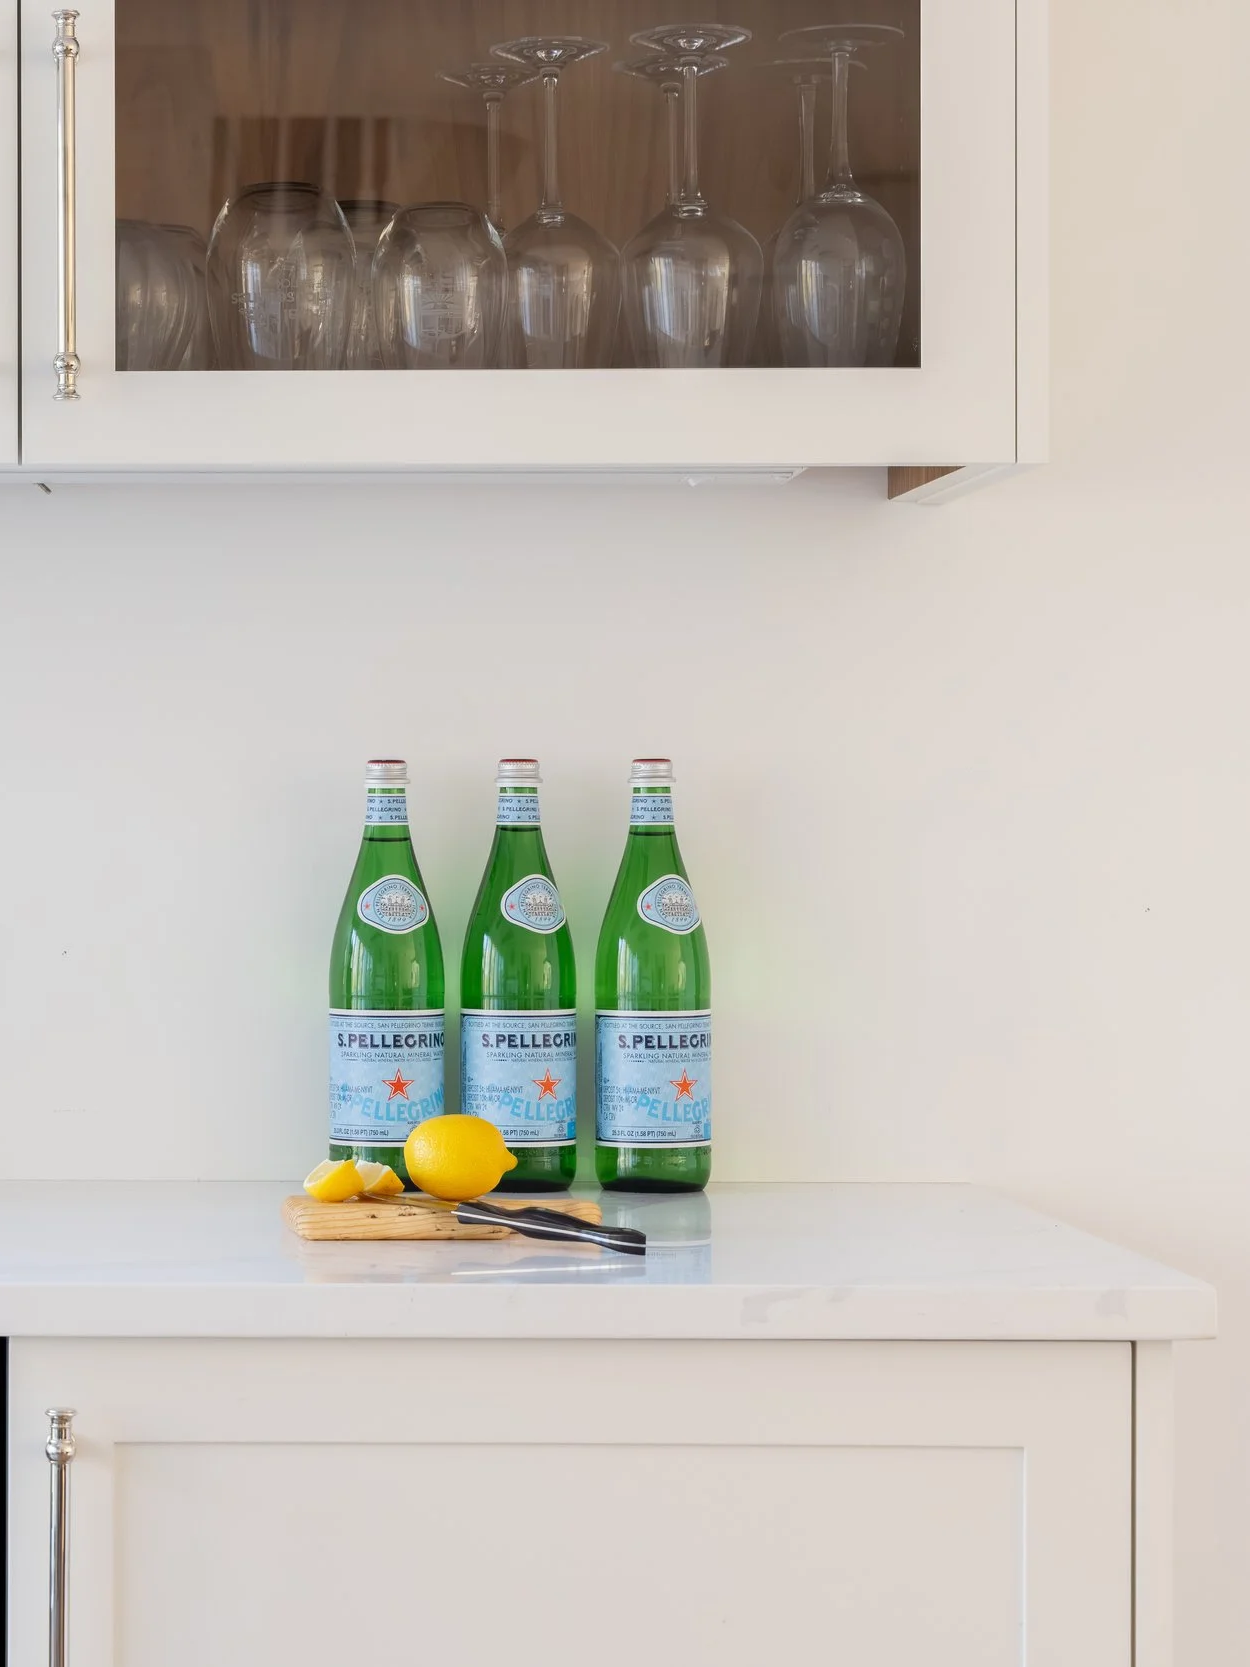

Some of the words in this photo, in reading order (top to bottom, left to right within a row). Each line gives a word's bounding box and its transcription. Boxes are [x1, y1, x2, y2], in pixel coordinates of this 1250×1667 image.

[341, 1051, 372, 1059] SPARKLING
[375, 1051, 405, 1059] NATURAL
[486, 1051, 523, 1059] SPARKLING
[524, 1051, 554, 1059] NATURAL
[623, 1052, 660, 1060] SPARKLING
[661, 1052, 690, 1060] NATURAL
